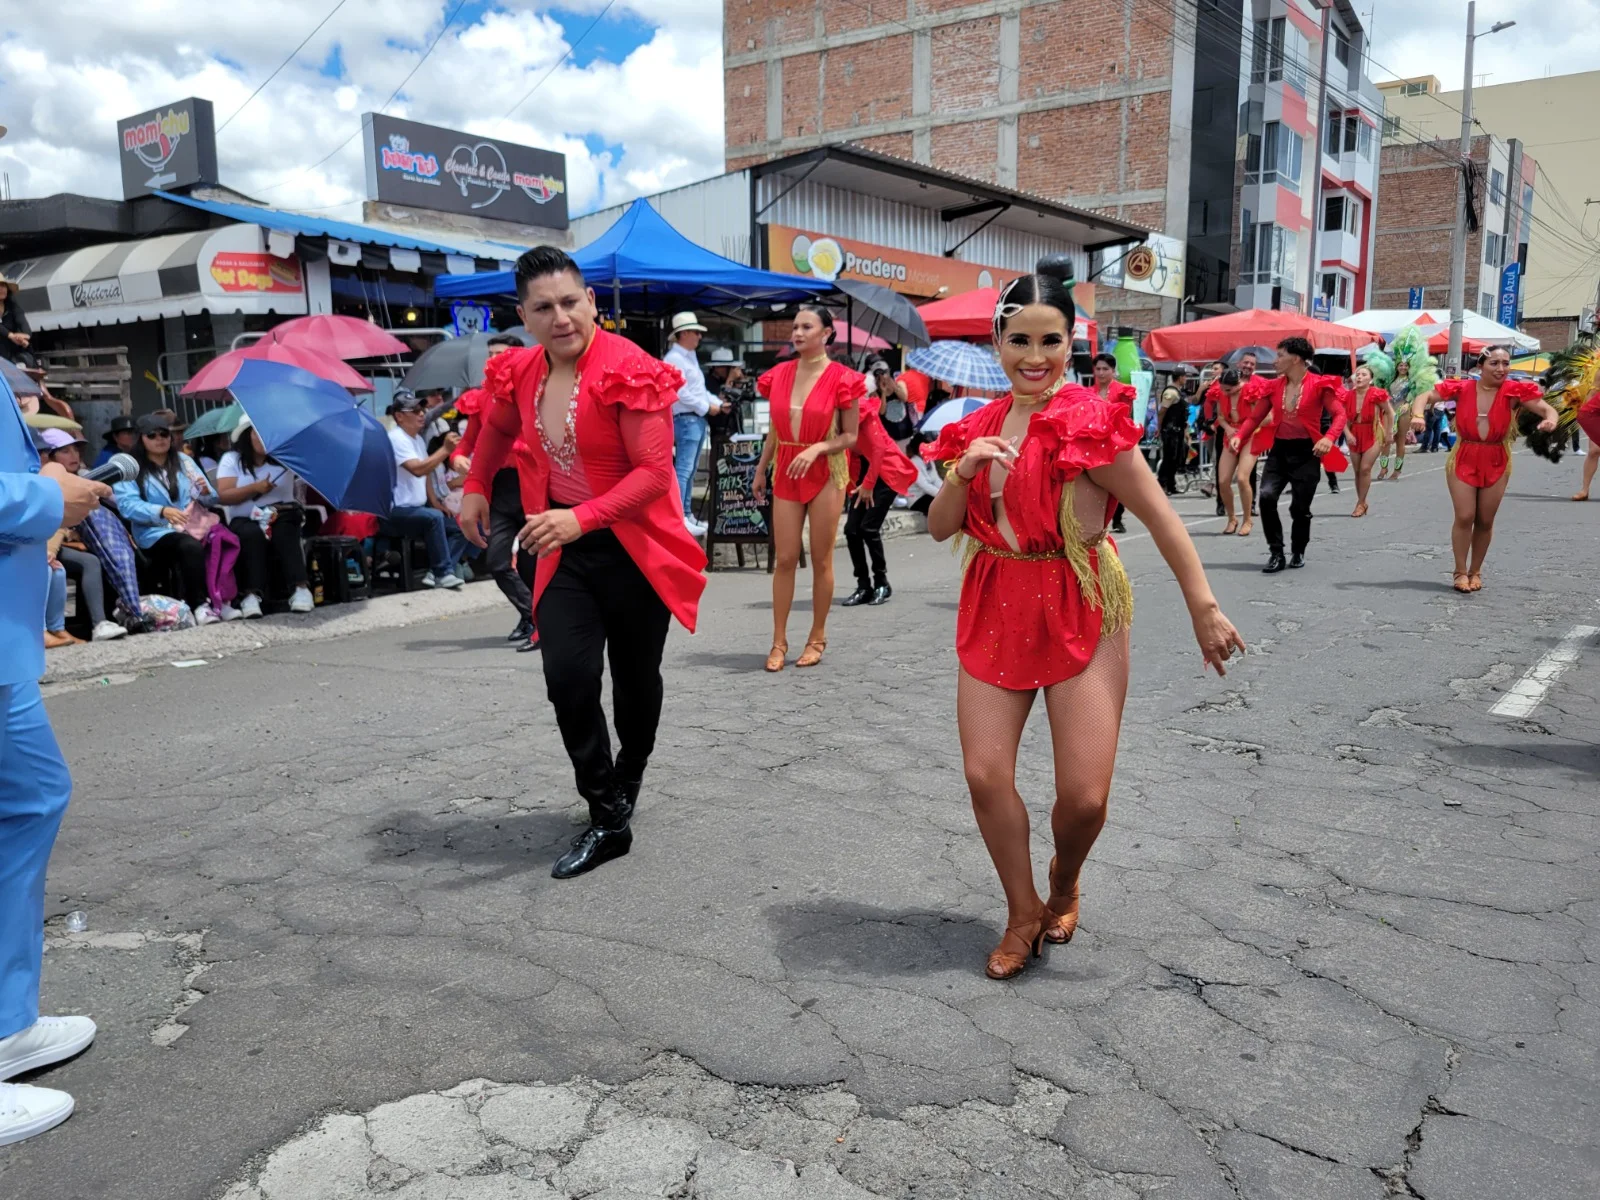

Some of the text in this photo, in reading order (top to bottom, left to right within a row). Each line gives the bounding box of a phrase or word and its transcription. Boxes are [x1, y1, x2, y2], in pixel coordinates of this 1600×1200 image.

[124, 108, 190, 151] momichu
[846, 251, 907, 282] Pradera
[1502, 270, 1516, 327] Cruz Azul
